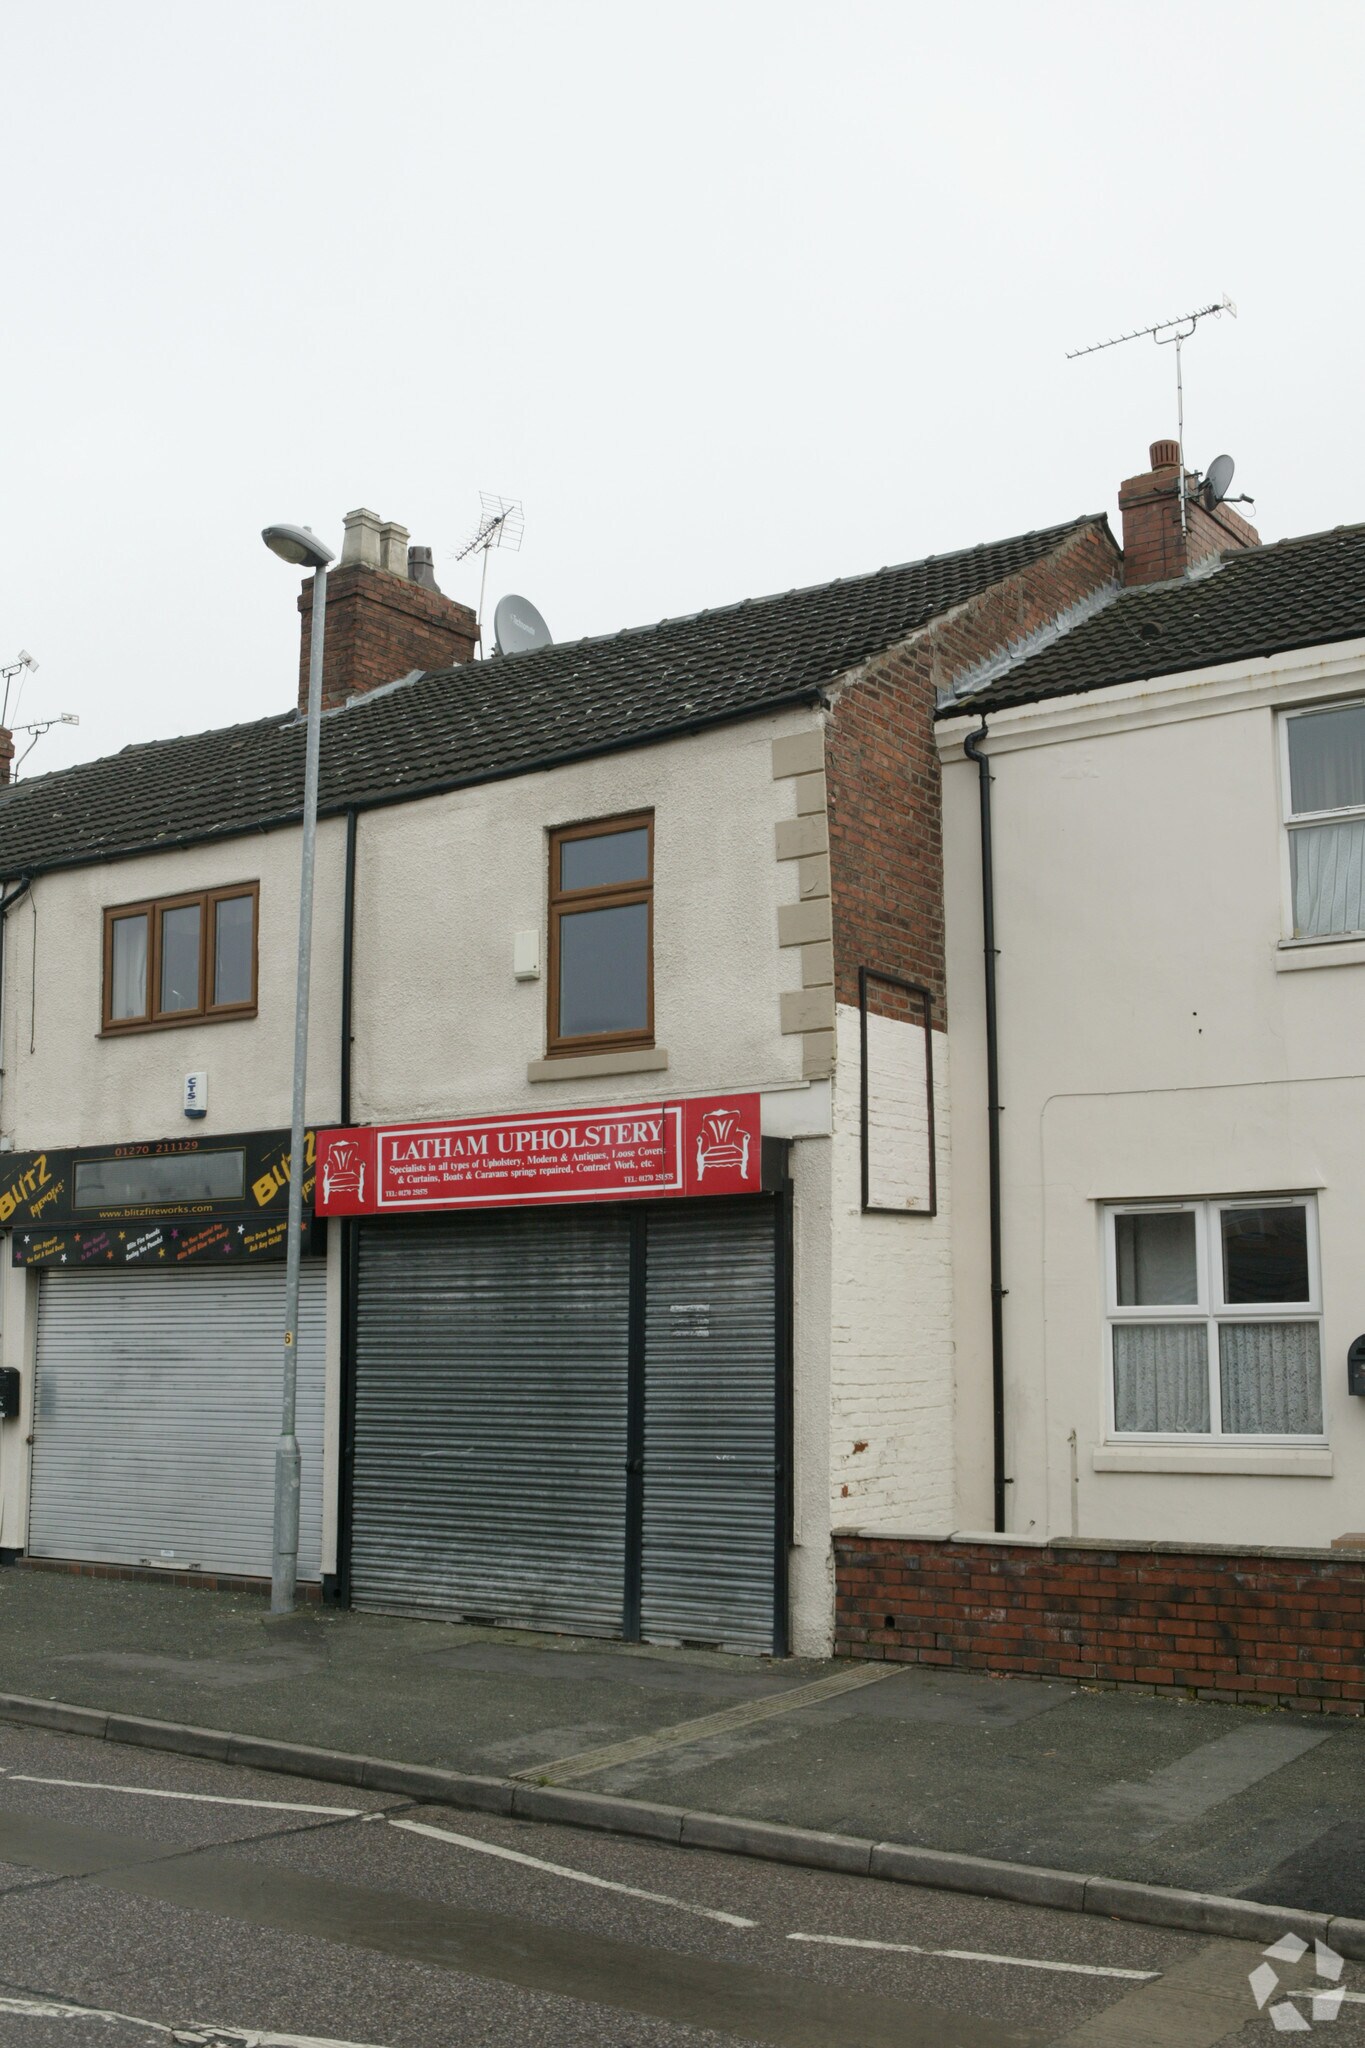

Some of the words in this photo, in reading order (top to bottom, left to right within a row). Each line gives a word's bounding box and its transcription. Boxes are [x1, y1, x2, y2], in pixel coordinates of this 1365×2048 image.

[187, 1077, 196, 1100] CTS
[115, 1145, 149, 1156] 01270
[156, 1141, 198, 1153] 211129
[391, 1135, 488, 1161] LATHAM
[497, 1119, 666, 1153] UPHOLSTERY
[252, 1130, 317, 1207] BLIZ
[389, 1163, 426, 1175] Specialists
[429, 1162, 436, 1171] in
[438, 1161, 448, 1171] all
[450, 1160, 469, 1172] types
[471, 1159, 480, 1168] of
[482, 1157, 525, 1169] Upholstery,
[527, 1154, 558, 1165] Modern
[560, 1152, 568, 1162] &
[572, 1150, 609, 1161] Antiques,
[612, 1149, 635, 1159] Loose
[397, 1175, 405, 1184] &
[406, 1173, 441, 1184] Curtains,
[443, 1172, 463, 1181] Boats
[465, 1171, 473, 1180] &
[474, 1169, 509, 1180] Caravans
[510, 1167, 537, 1179] springs
[539, 1164, 574, 1176] repaired,
[576, 1162, 611, 1173] Contract
[614, 1160, 639, 1169] Work,
[624, 1175, 638, 1183] TEL:
[99, 1205, 213, 1218] www.blitzfireworks.com
[284, 1332, 292, 1345] 6
